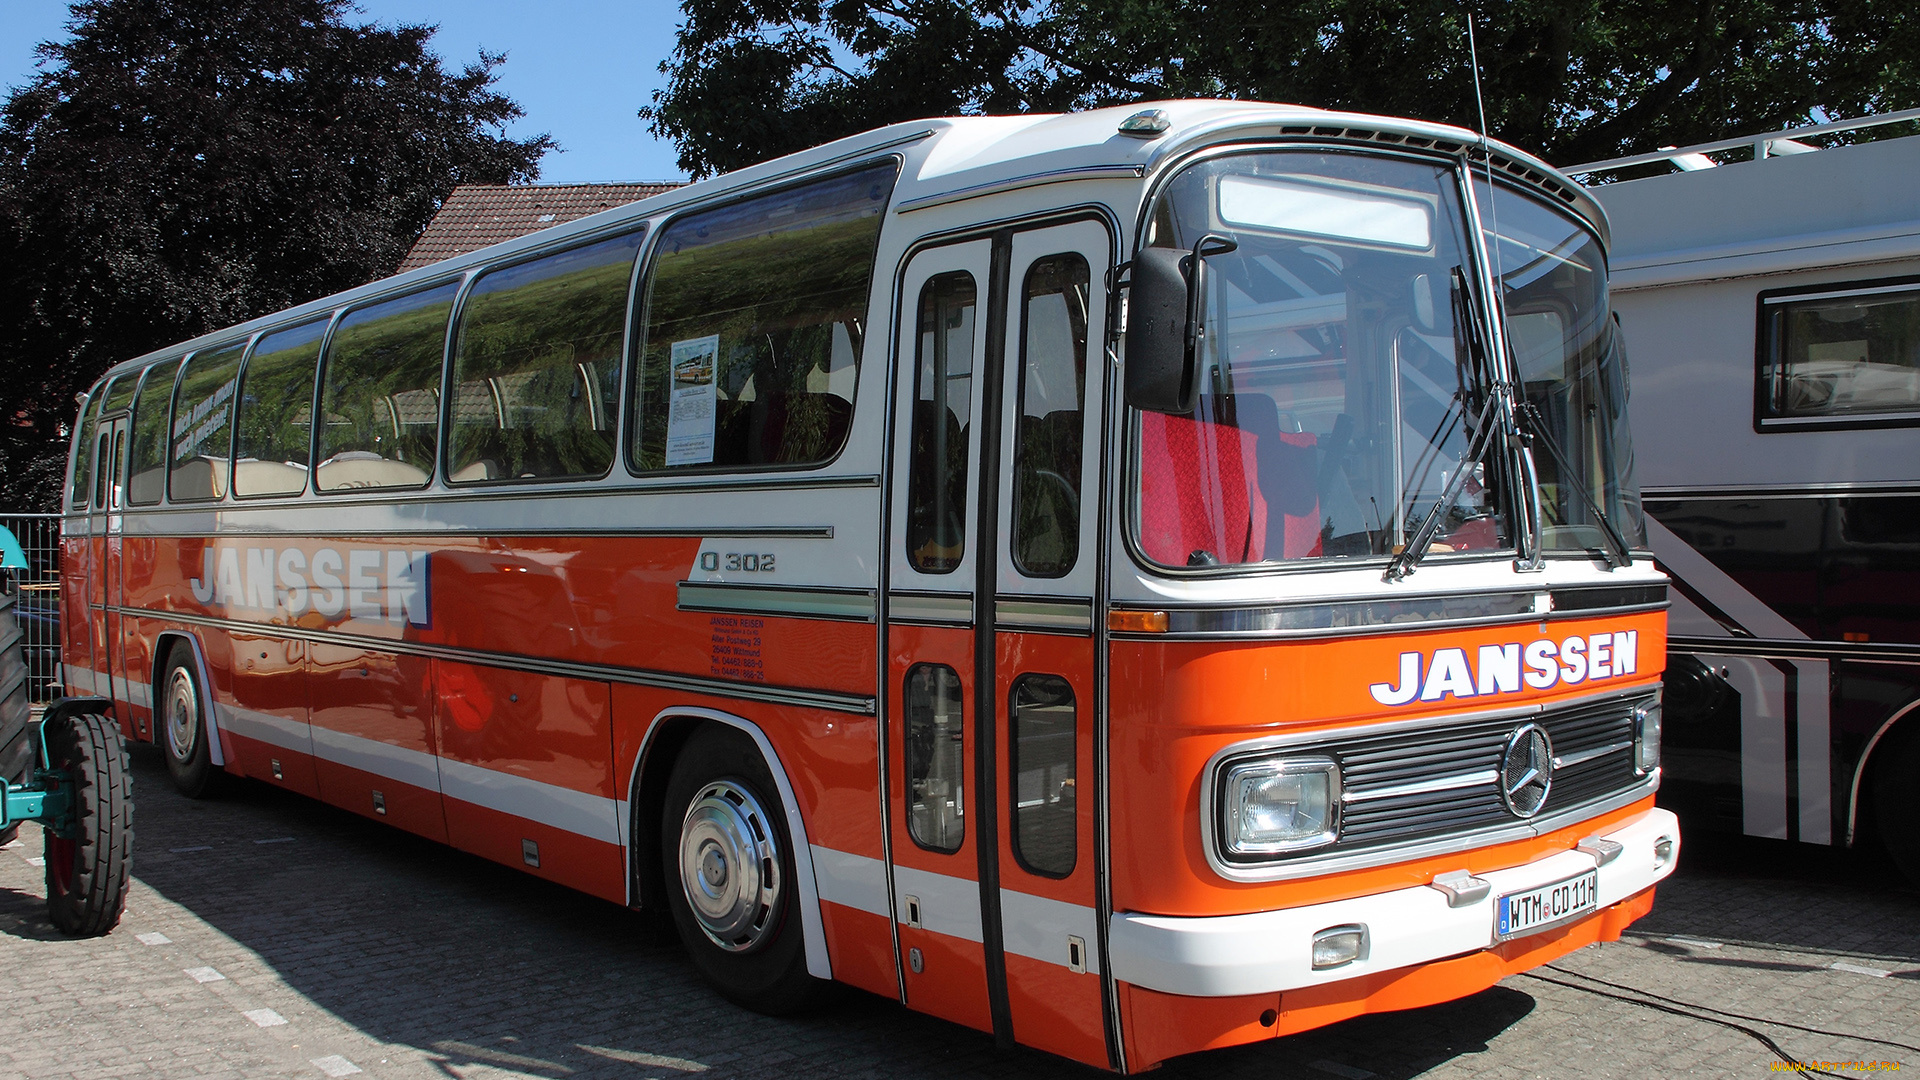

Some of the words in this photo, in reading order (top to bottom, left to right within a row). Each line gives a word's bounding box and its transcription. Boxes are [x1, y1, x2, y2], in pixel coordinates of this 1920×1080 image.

[725, 553, 776, 572] 302
[190, 547, 432, 629] JANSSEN
[710, 617, 738, 626] JANSSEN
[740, 619, 764, 628] REISEN
[726, 635, 751, 647] Postweg
[733, 647, 760, 657] Wittmund
[1369, 629, 1639, 706] JANSSEN
[1510, 893, 1542, 928] WTM
